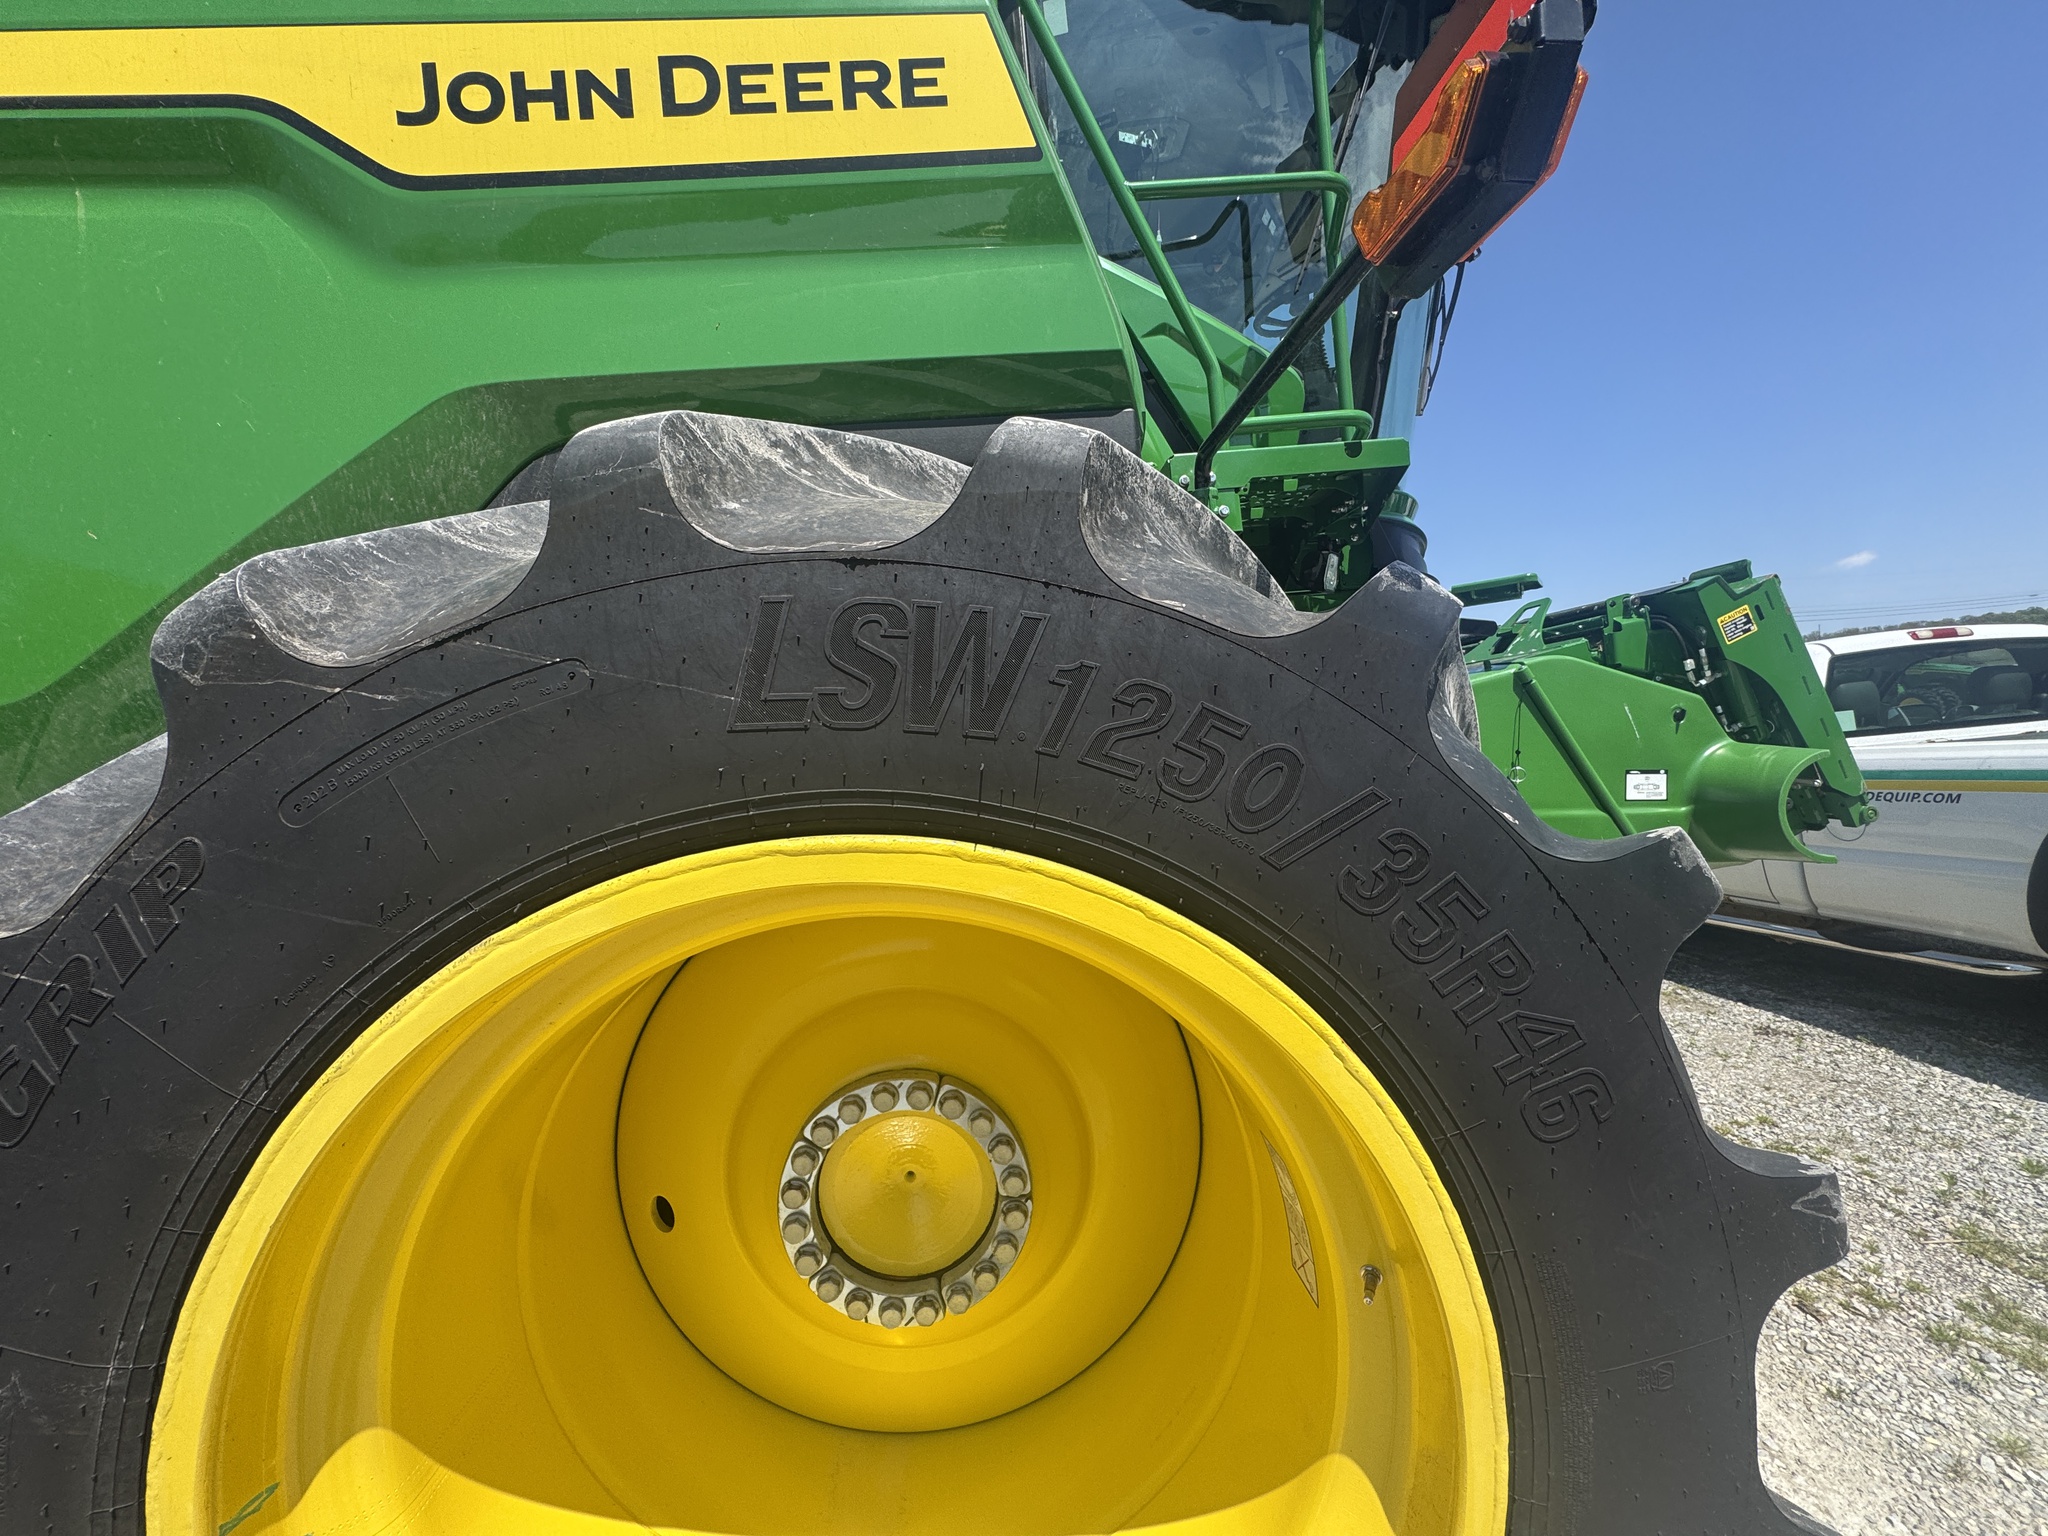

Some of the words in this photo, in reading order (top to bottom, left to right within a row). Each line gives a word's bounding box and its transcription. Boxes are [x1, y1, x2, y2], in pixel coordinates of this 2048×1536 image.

[396, 61, 634, 127] JOHN
[657, 55, 949, 118] DEERE
[1723, 606, 1748, 622] CAUTION
[336, 761, 355, 776] MAX
[355, 746, 378, 763] LOAD
[381, 739, 391, 750] AT
[303, 785, 329, 809] 202
[327, 778, 339, 792] B
[1116, 782, 1168, 809] REPLACES
[726, 595, 1050, 740] LSW
[1035, 660, 1617, 1144] 1250/35R46
